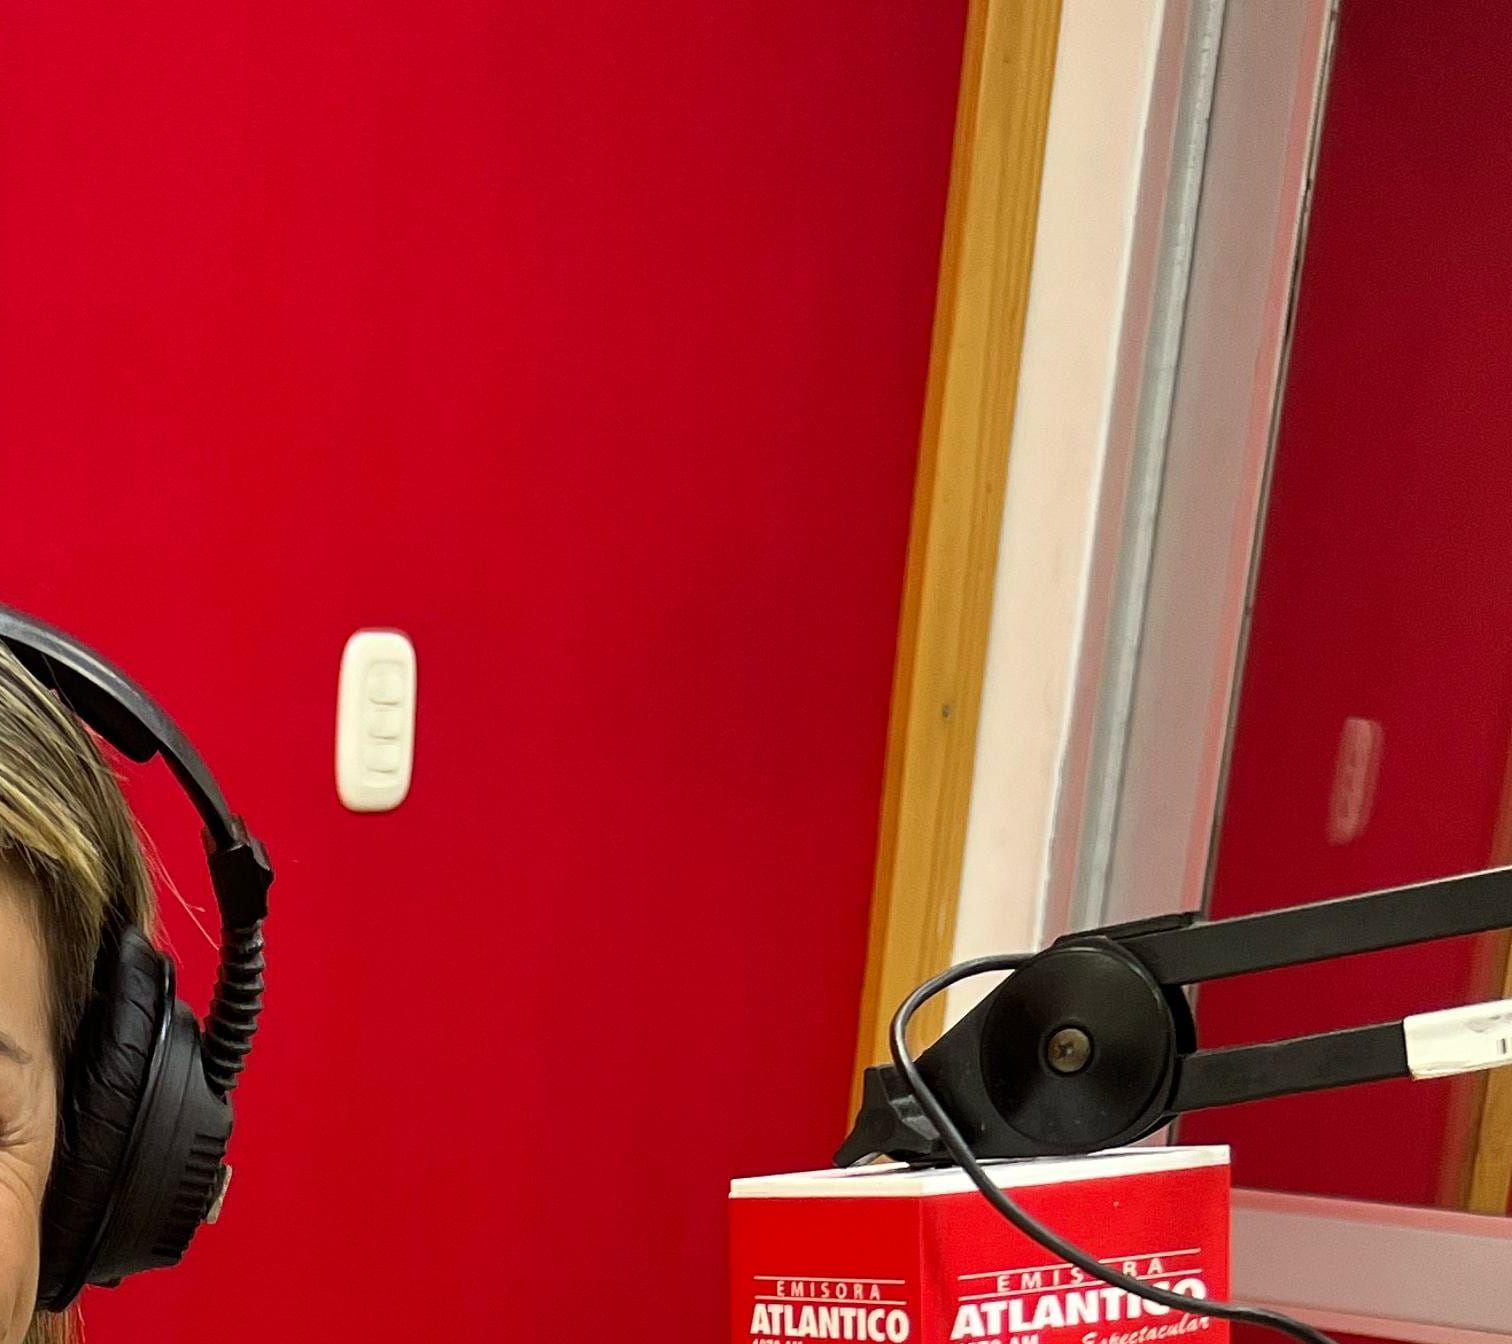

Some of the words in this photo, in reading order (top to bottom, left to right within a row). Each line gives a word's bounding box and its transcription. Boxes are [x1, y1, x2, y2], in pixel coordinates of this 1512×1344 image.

[777, 1279, 882, 1299] EMISORA
[998, 1257, 1165, 1293] EMISRA
[750, 1303, 909, 1341] ATLANTICO
